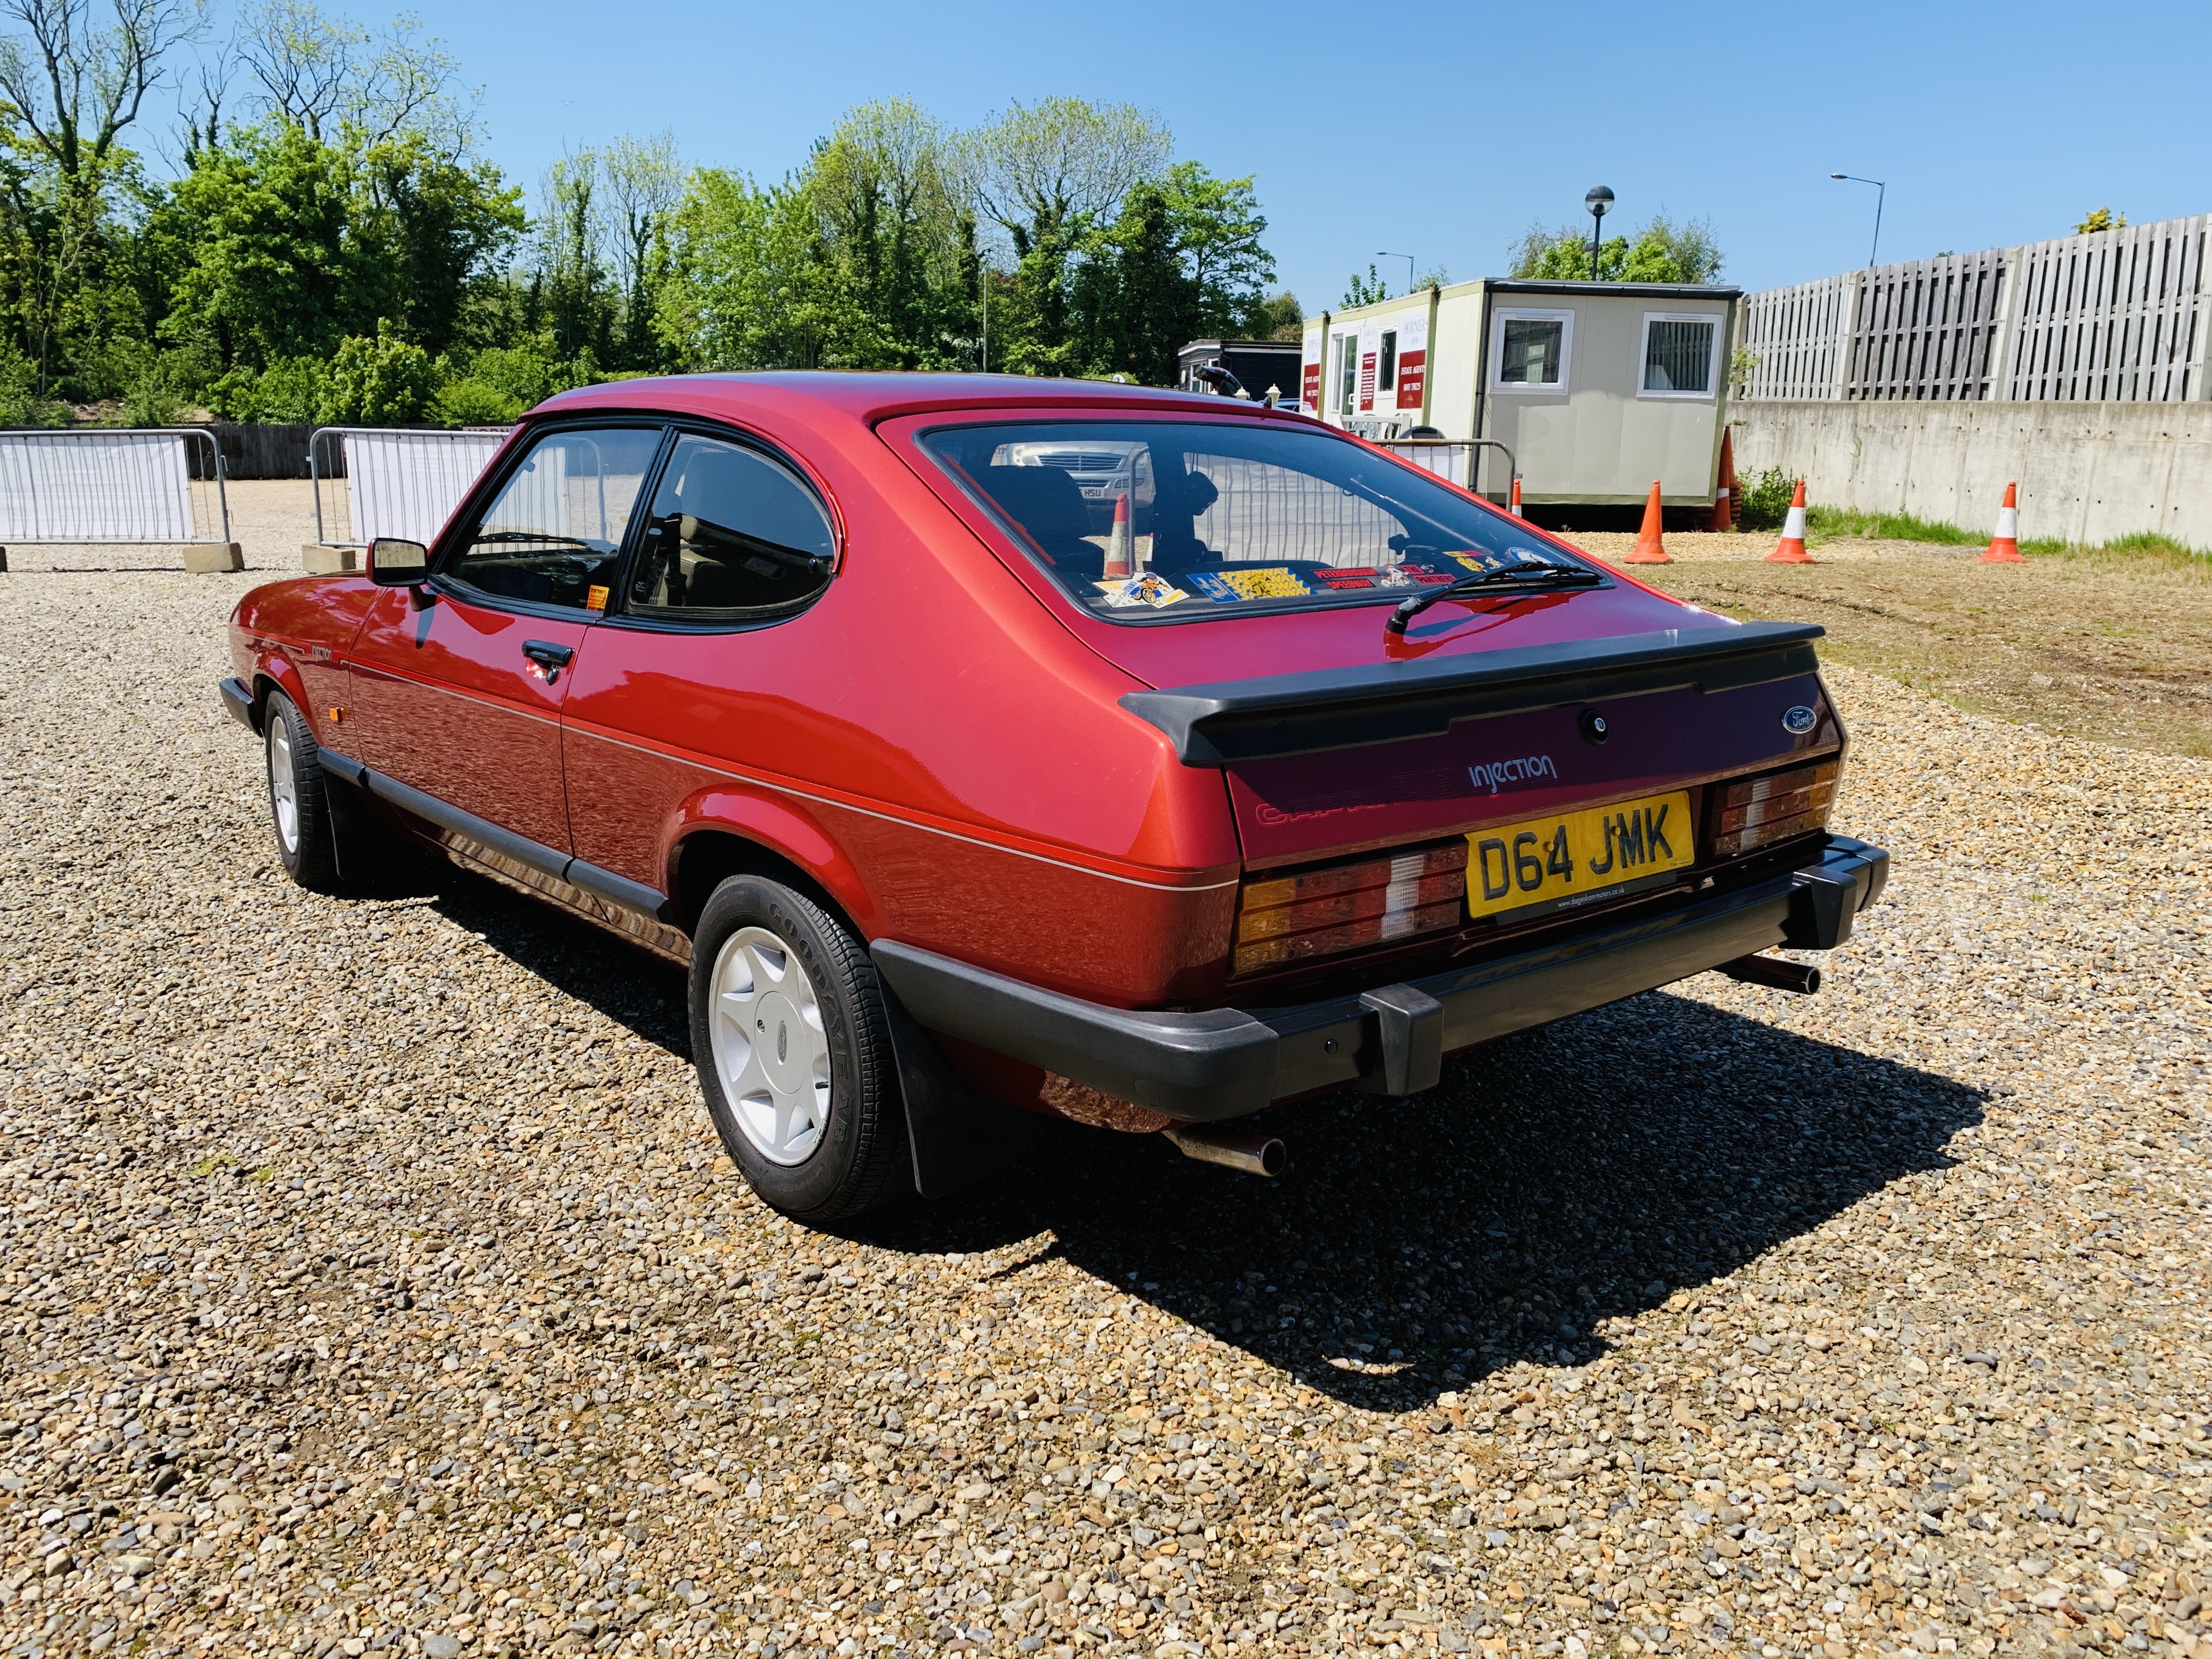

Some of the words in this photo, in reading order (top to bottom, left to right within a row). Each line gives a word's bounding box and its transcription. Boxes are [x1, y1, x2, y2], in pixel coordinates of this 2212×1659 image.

[1404, 318, 1429, 335] HORNERS
[1401, 366, 1413, 375] ESTATE
[1122, 581, 1137, 592] STARS
[1792, 712, 1809, 727] Ford
[1479, 825, 1574, 901] D64
[1589, 804, 1673, 875] JMK
[1558, 885, 1624, 908] www.dagenhammotors.co.uk
